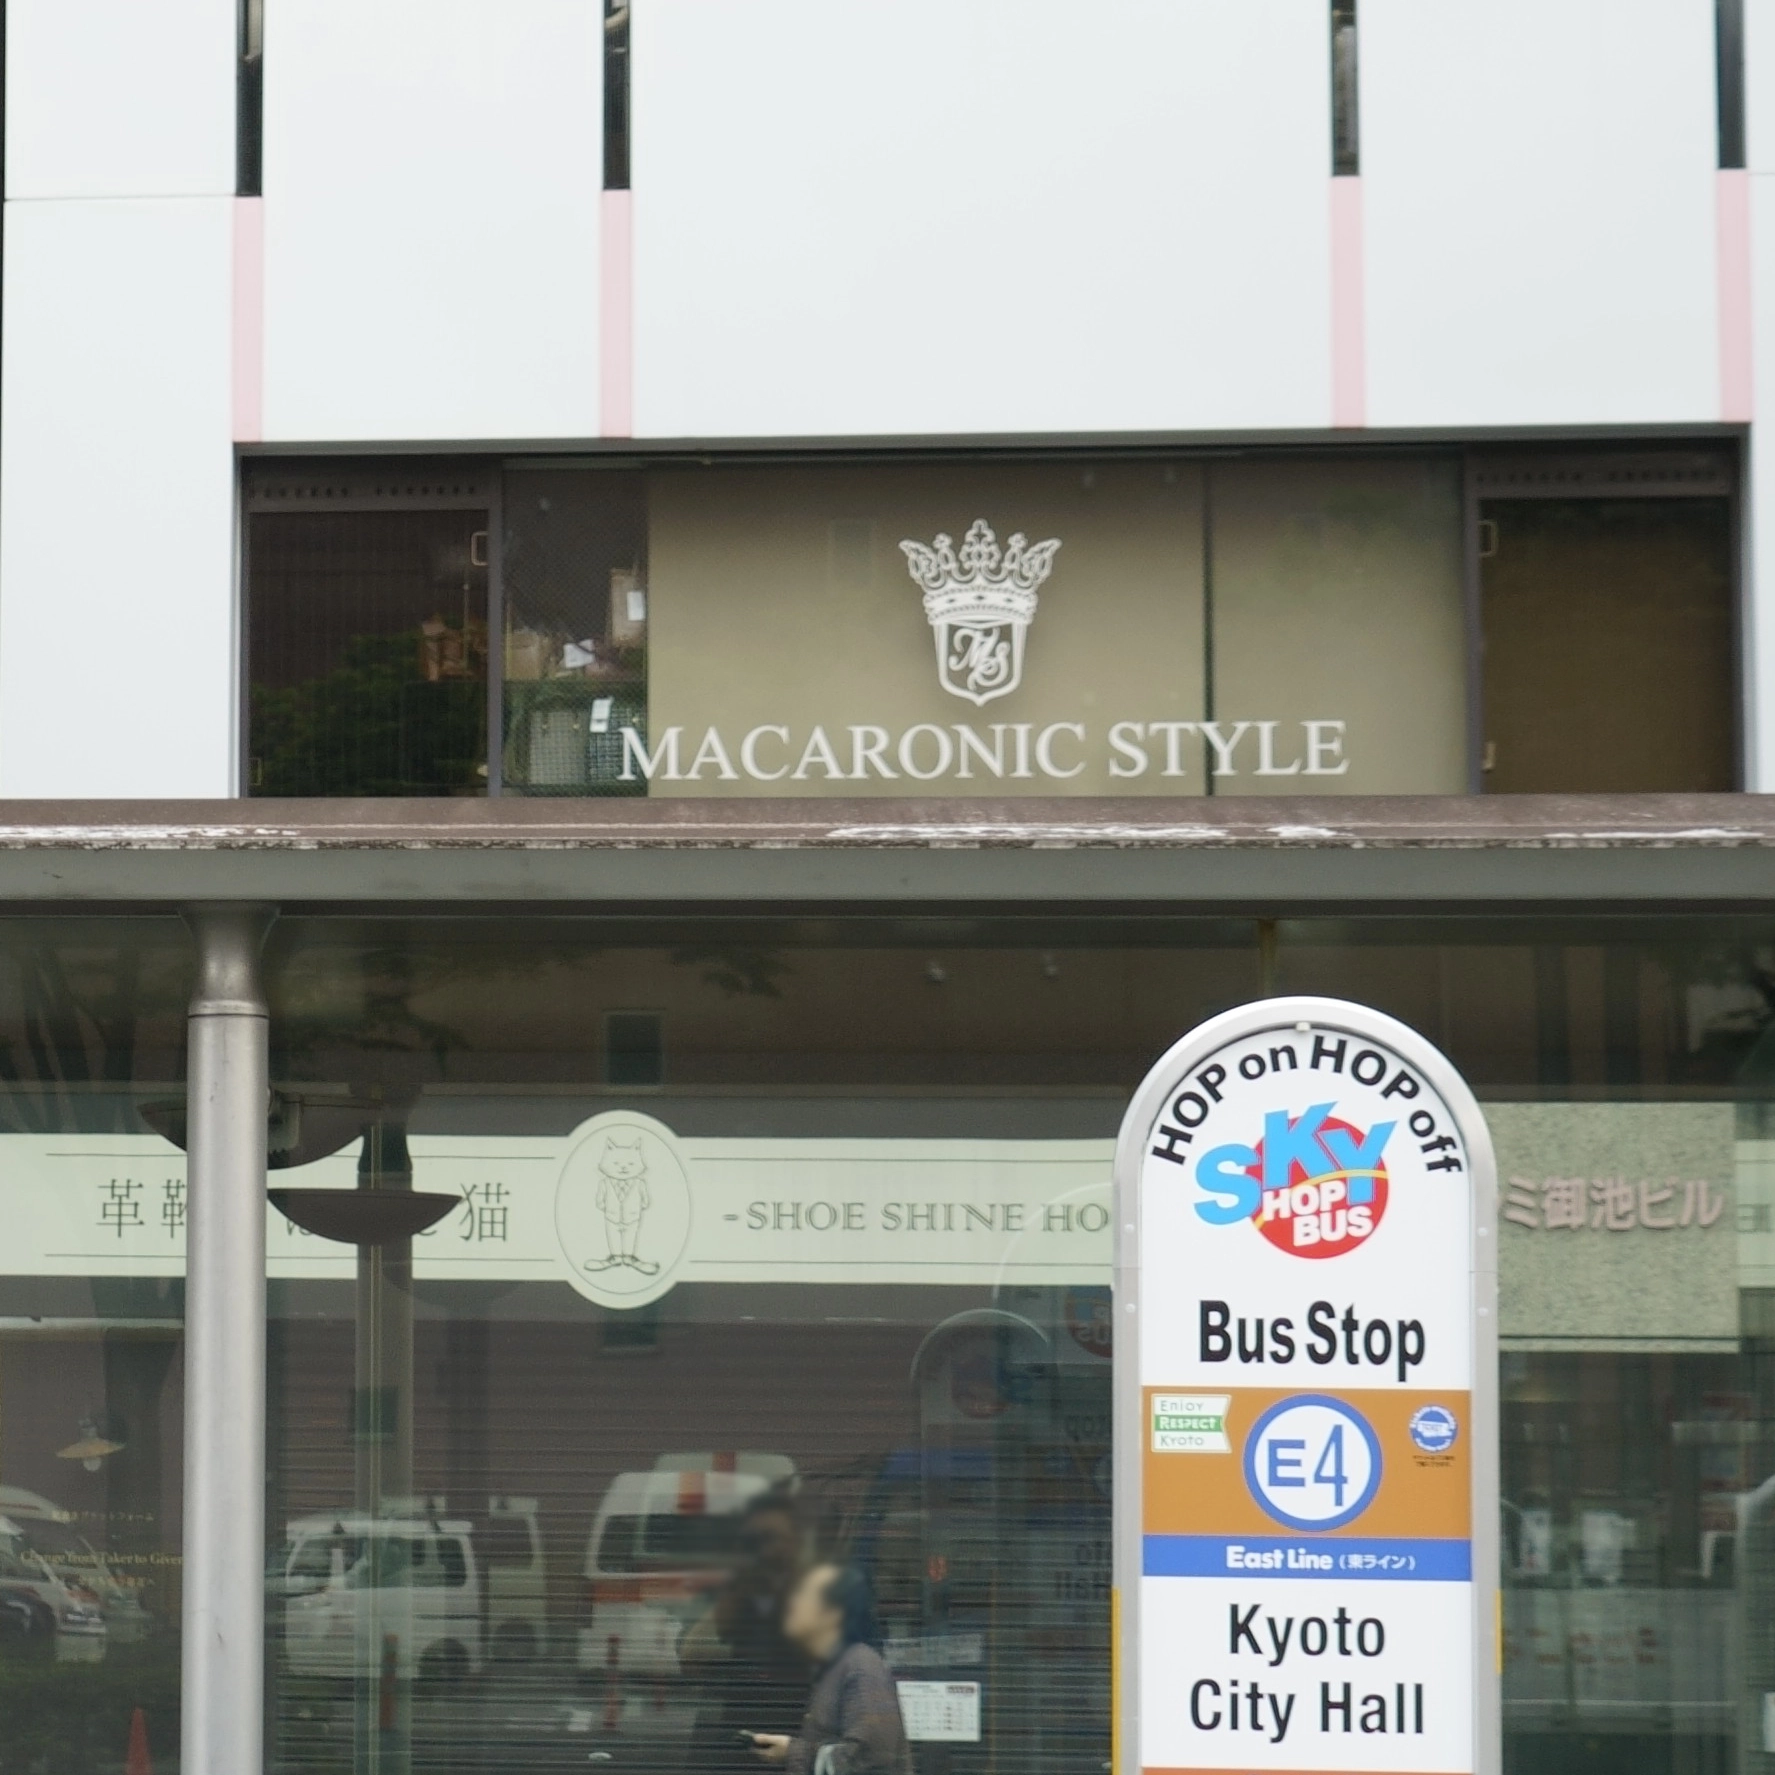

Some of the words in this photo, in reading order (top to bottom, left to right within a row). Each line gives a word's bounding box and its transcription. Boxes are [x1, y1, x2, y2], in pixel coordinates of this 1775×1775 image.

[618, 722, 1087, 781] MACARONIC
[1109, 719, 1349, 778] STYLE
[1152, 1063, 1227, 1165] HOP
[1239, 1044, 1298, 1081] on
[1310, 1035, 1420, 1103] HOP
[1409, 1109, 1462, 1174] off
[1193, 1101, 1399, 1226] SKY
[881, 1203, 1026, 1232] SHINE
[1263, 1182, 1347, 1223] HOP
[1293, 1206, 1373, 1247] BUS
[1497, 1174, 1725, 1232] ミ御池ビル
[1199, 1300, 1295, 1364] Bus
[1307, 1300, 1425, 1382] Stop
[1268, 1424, 1349, 1507] E4
[1227, 1545, 1283, 1569] East
[1287, 1547, 1333, 1570] Line
[1229, 1603, 1385, 1667] Kyoto
[1190, 1678, 1295, 1744] City
[1321, 1681, 1424, 1735] Hall
